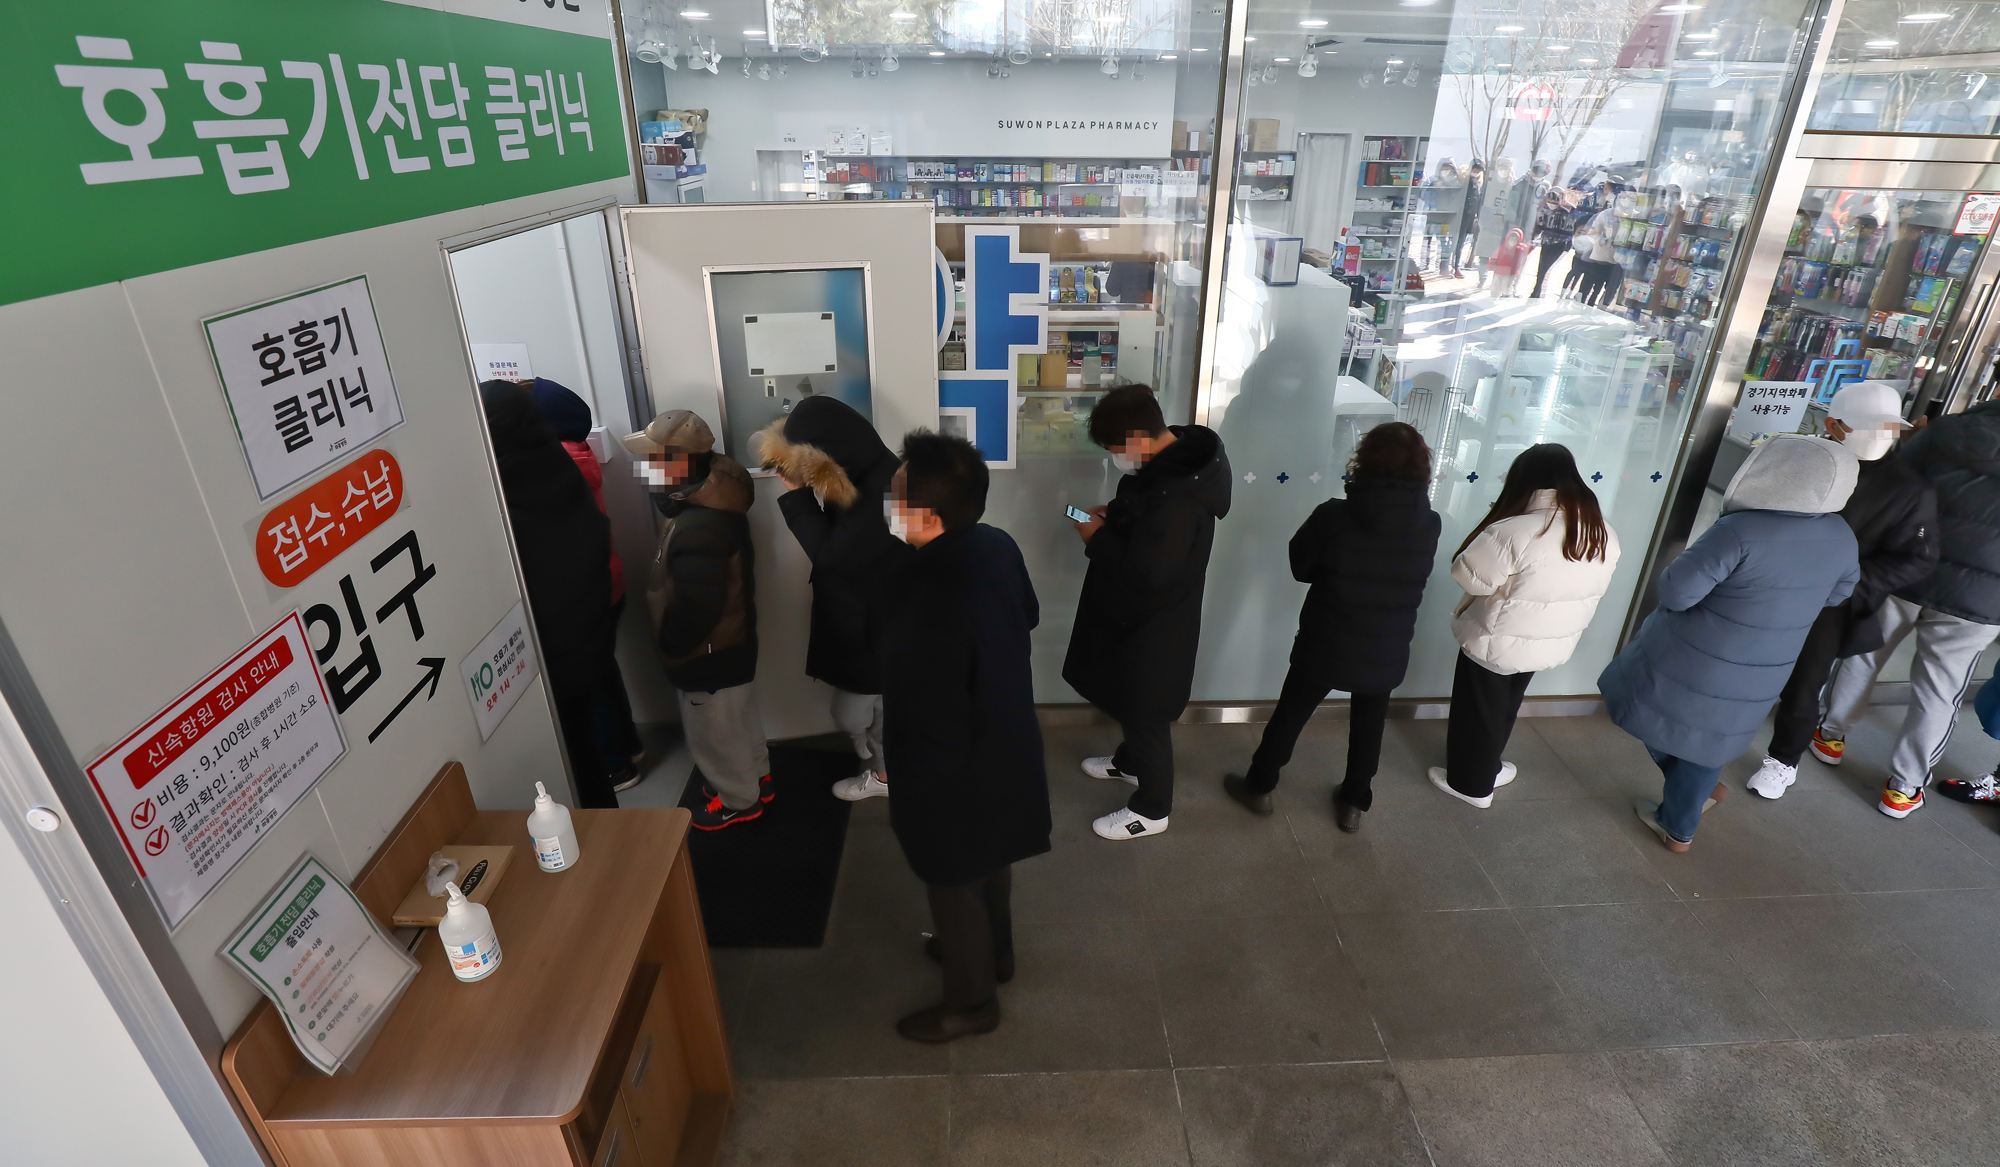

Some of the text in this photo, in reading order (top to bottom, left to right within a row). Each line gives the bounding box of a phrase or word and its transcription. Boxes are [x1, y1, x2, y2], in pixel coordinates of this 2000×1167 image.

[54, 35, 594, 195] 호흡기전담 클리닉
[998, 120, 1159, 130] SUWON PLAZA PHARMACY
[1962, 212, 1978, 220] CCTV
[251, 307, 358, 387] 호흡기
[273, 366, 374, 453] 클리닉
[1747, 387, 1808, 399] 경기지역화폐
[1751, 404, 1791, 415] 사용가능
[267, 460, 394, 574] 접수,수납
[303, 530, 436, 715] 입구
[149, 651, 279, 767] 신속항원 검사 안내
[487, 692, 498, 711] 오후
[500, 678, 510, 694] 1시
[516, 659, 525, 675] 2시
[157, 774, 189, 806] 비용
[283, 682, 300, 699] 기준)
[170, 774, 227, 833] 결과확인
[238, 747, 259, 772] 검사
[260, 736, 271, 750] 후
[273, 711, 297, 740] 1시간
[300, 695, 317, 716] 소요
[181, 772, 254, 842] 검사결과는 문자로 안내됩니다.
[190, 836, 212, 860] 검사결과
[212, 819, 229, 837] 양성일
[230, 812, 236, 820] 시
[236, 801, 247, 814] PCR
[226, 812, 247, 835] 필요하신
[259, 778, 282, 804] 문자메시지
[282, 768, 291, 779] 확인
[231, 829, 242, 842] 내원
[242, 809, 264, 830] 바랍니다.
[185, 817, 220, 852] (문자메시지는
[256, 880, 321, 956] 호흡기 전담 클리닉
[286, 908, 319, 948] 출입안내
[292, 950, 312, 976] 손소독제
[312, 938, 322, 951] 사용
[342, 993, 359, 1011] 주세요
